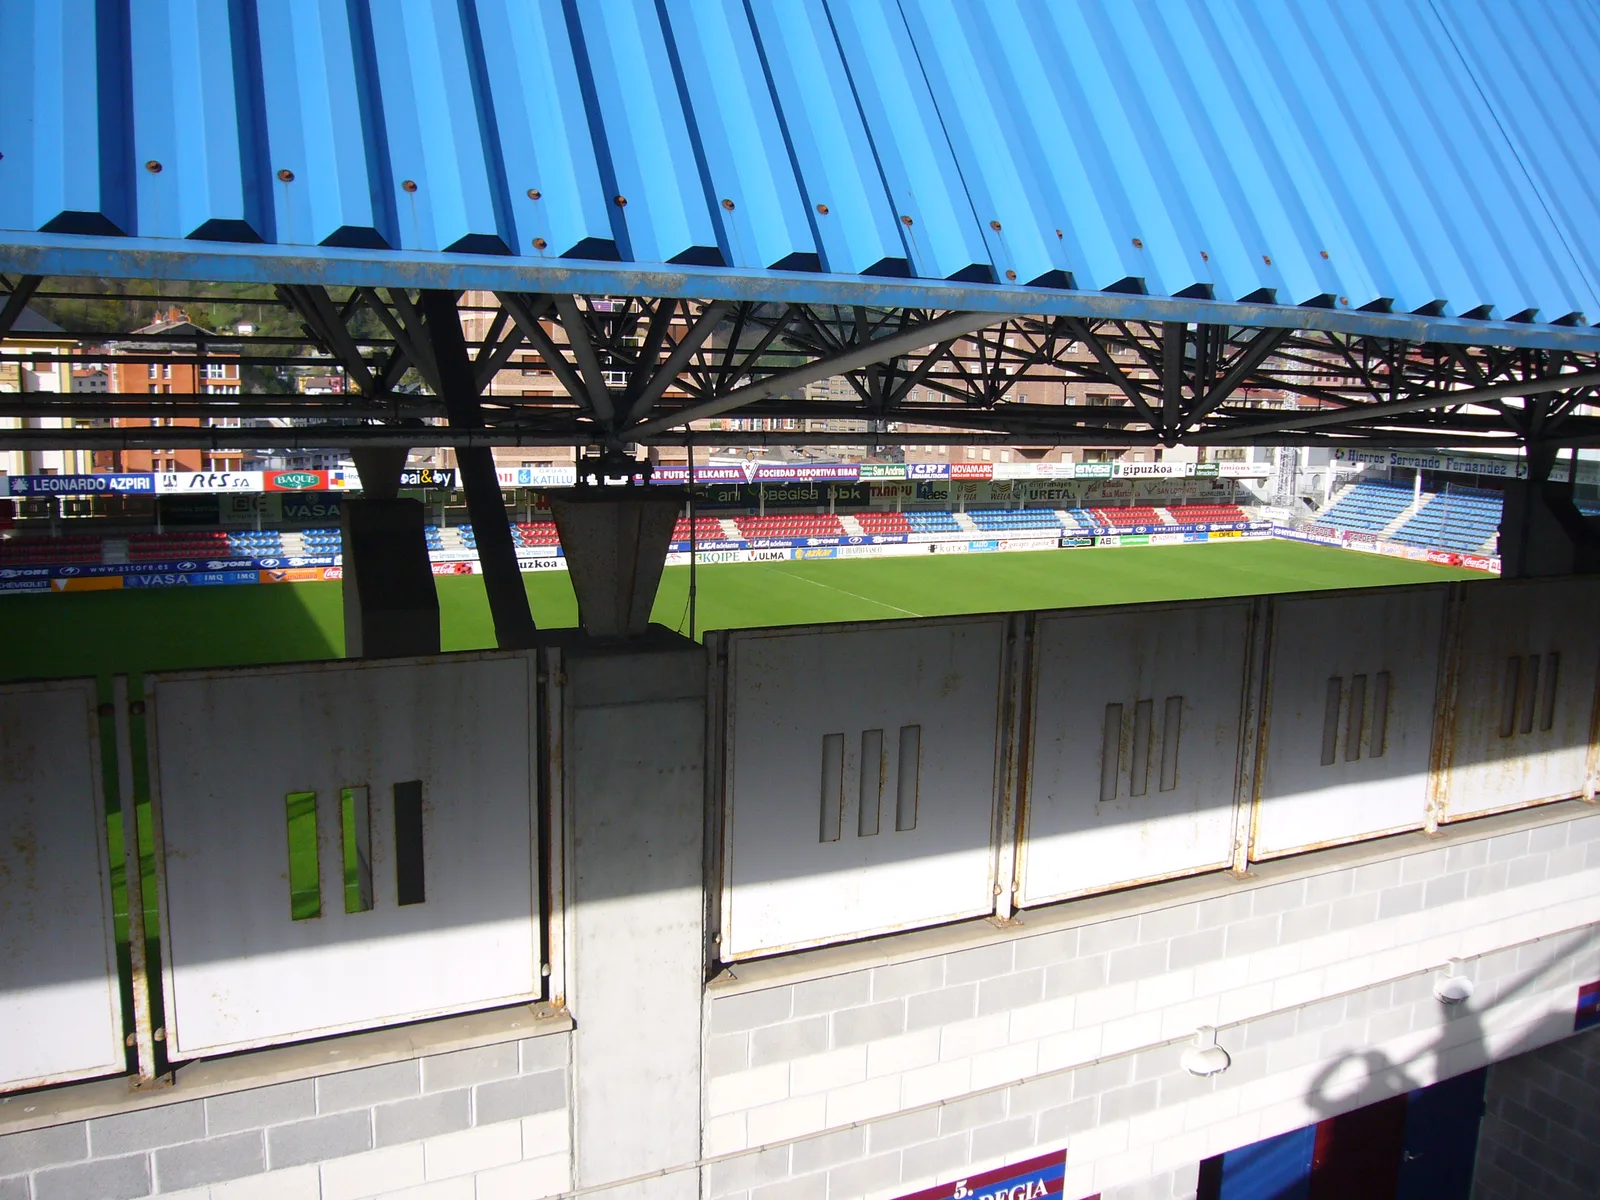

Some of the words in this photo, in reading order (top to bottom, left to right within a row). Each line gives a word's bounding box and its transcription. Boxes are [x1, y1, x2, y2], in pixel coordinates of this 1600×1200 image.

[1347, 450, 1384, 464] Hierros
[1390, 452, 1440, 469] Servando
[1446, 456, 1507, 475] Fernandez
[759, 468, 795, 478] SOCIEDAD
[797, 468, 837, 477] DEPORTIVA
[838, 468, 858, 477] EIBAR
[915, 464, 947, 473] CRF
[952, 464, 993, 473] NOVAMARK
[1123, 464, 1172, 476] gipuzkoa
[664, 470, 696, 479] FUTBO
[699, 469, 740, 478] ELKARTEA
[33, 478, 106, 491] LEONARDO
[109, 477, 150, 490] AZPIRI
[533, 475, 573, 485] KATILLU
[1029, 488, 1069, 500] URETA
[283, 504, 340, 518] VASA
[699, 541, 716, 549] LIGA
[716, 541, 739, 549] adelante
[753, 539, 769, 547] LIGA
[1100, 537, 1117, 545] ABC
[940, 544, 967, 553] kutxa
[759, 551, 784, 560] ULMA
[519, 559, 558, 569] uzkoa
[1464, 557, 1489, 569] Coca-Cola
[90, 564, 168, 573] www.astore.es
[140, 574, 188, 584] VASA
[237, 572, 256, 580] IMQ
[953, 1180, 974, 1200] 5.
